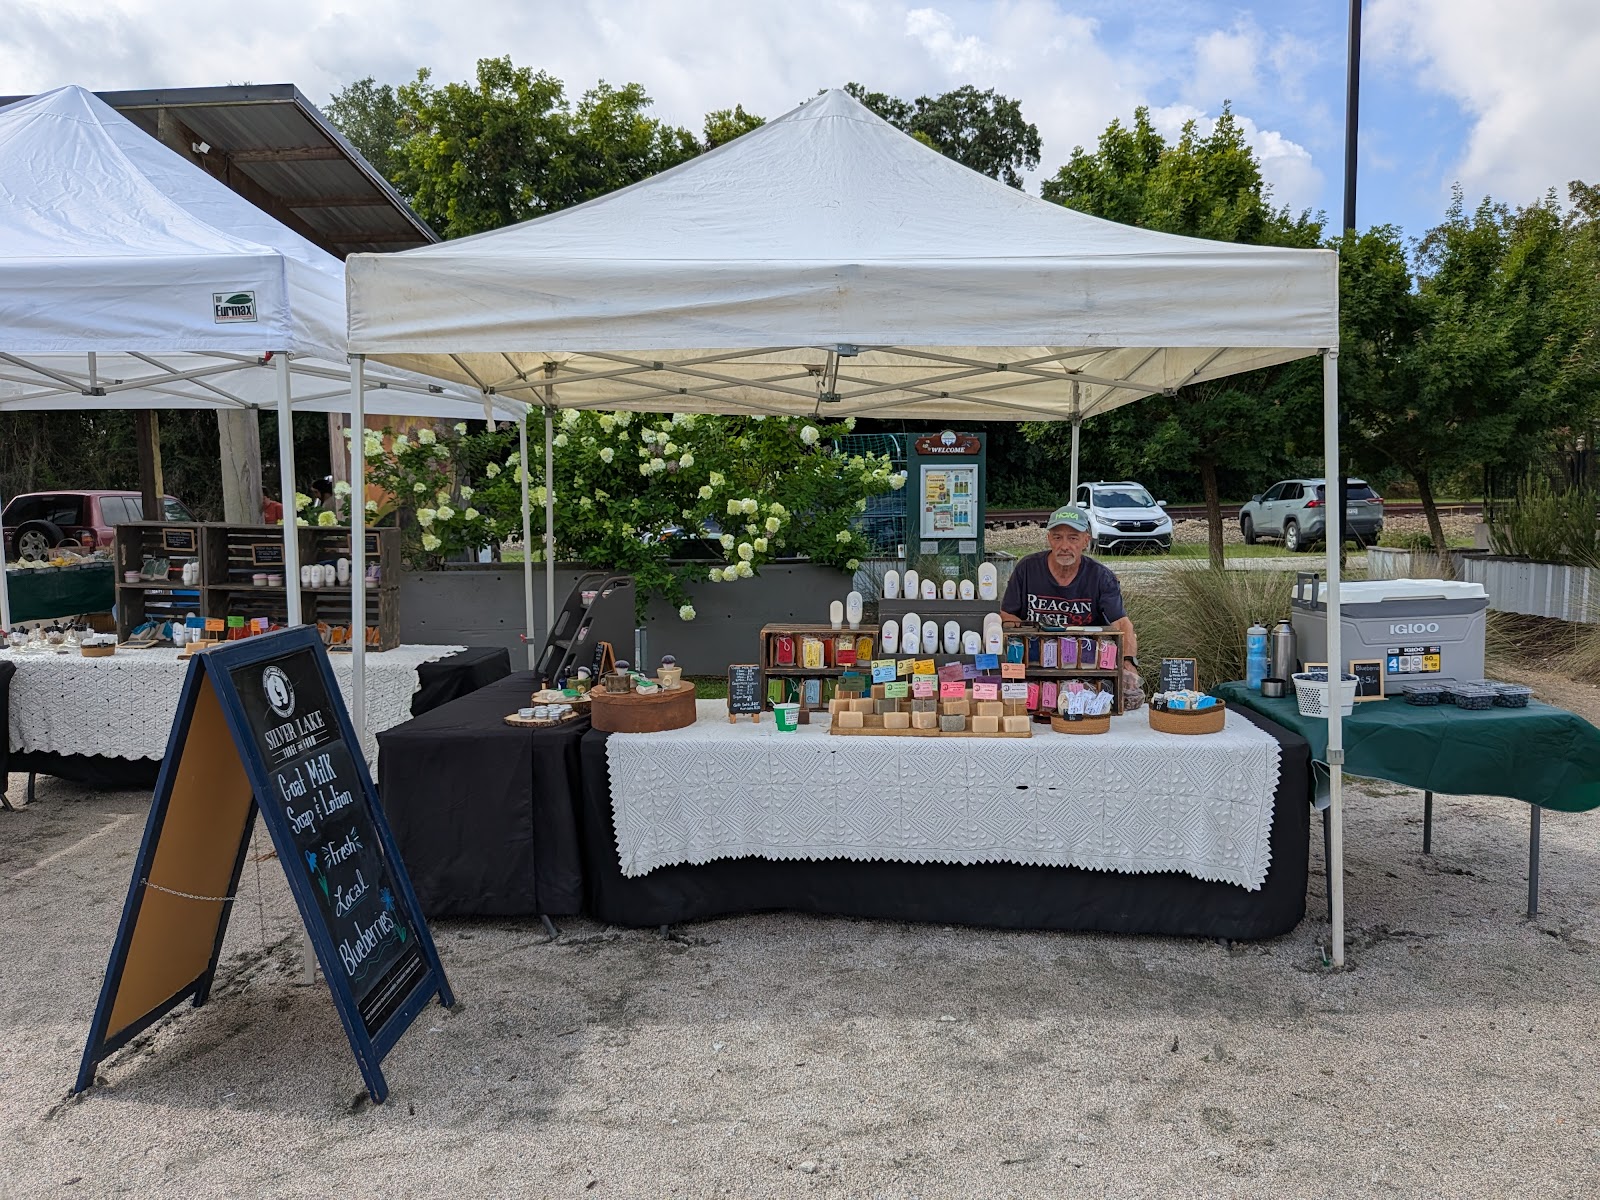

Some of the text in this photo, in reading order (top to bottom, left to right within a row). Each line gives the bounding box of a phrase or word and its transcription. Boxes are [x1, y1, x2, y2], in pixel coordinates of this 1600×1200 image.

[215, 304, 252, 317] Eurmax
[1055, 512, 1079, 521] HOKA
[1027, 594, 1092, 614] REAGAN
[1389, 622, 1440, 635] IGLOO
[1388, 658, 1398, 668] 4
[264, 710, 326, 751] SILVER LAKE
[278, 768, 307, 801] Goat
[286, 806, 316, 834] Soap
[318, 785, 353, 815] Lotion
[328, 835, 357, 866] Fresh
[334, 868, 370, 918] Local
[338, 910, 395, 977] Blueberries
